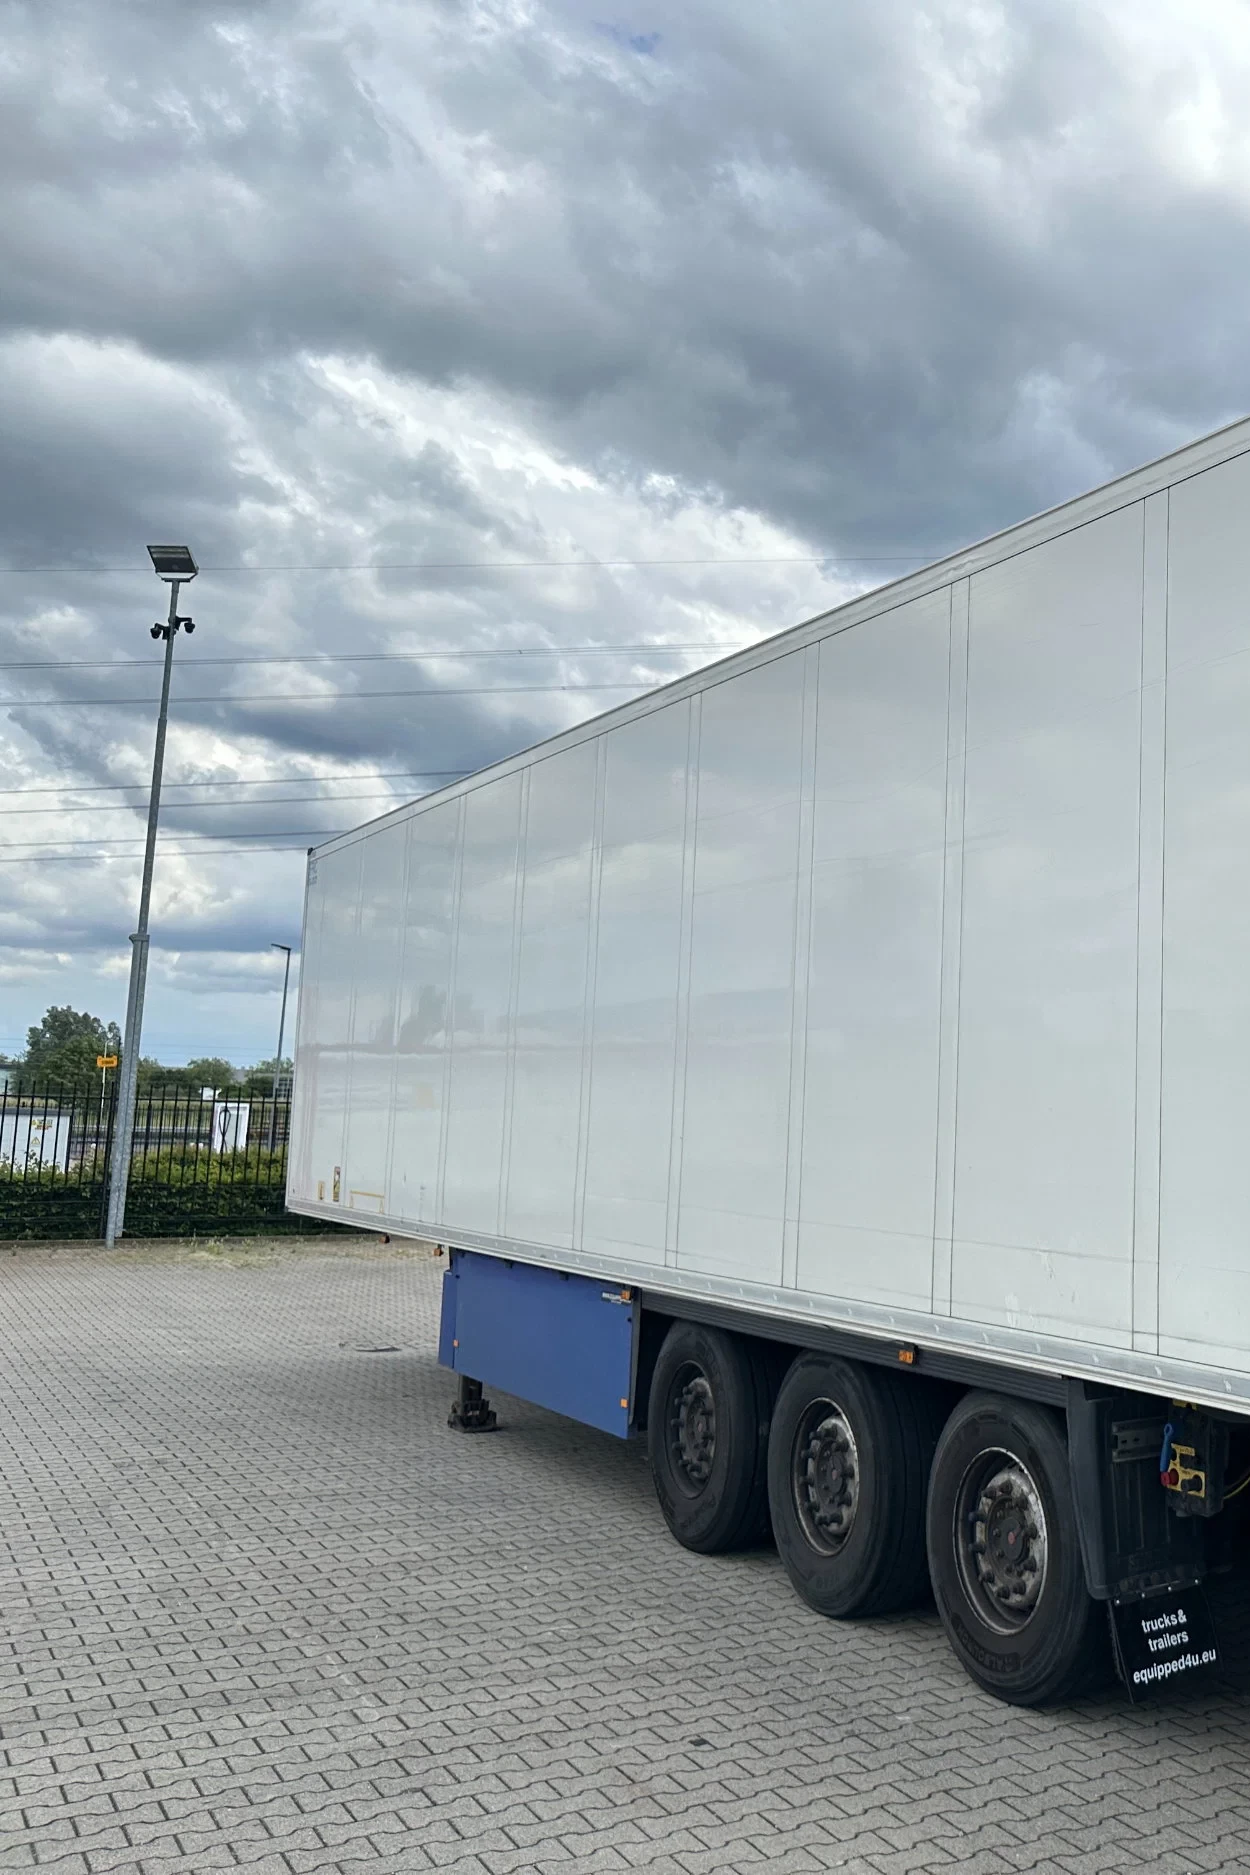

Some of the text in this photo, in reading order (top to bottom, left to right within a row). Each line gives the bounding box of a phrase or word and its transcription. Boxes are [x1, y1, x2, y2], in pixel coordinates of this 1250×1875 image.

[1141, 1608, 1187, 1634] trucks&
[1147, 1630, 1189, 1652] trailers
[1132, 1648, 1217, 1685] equipped4u.eu
